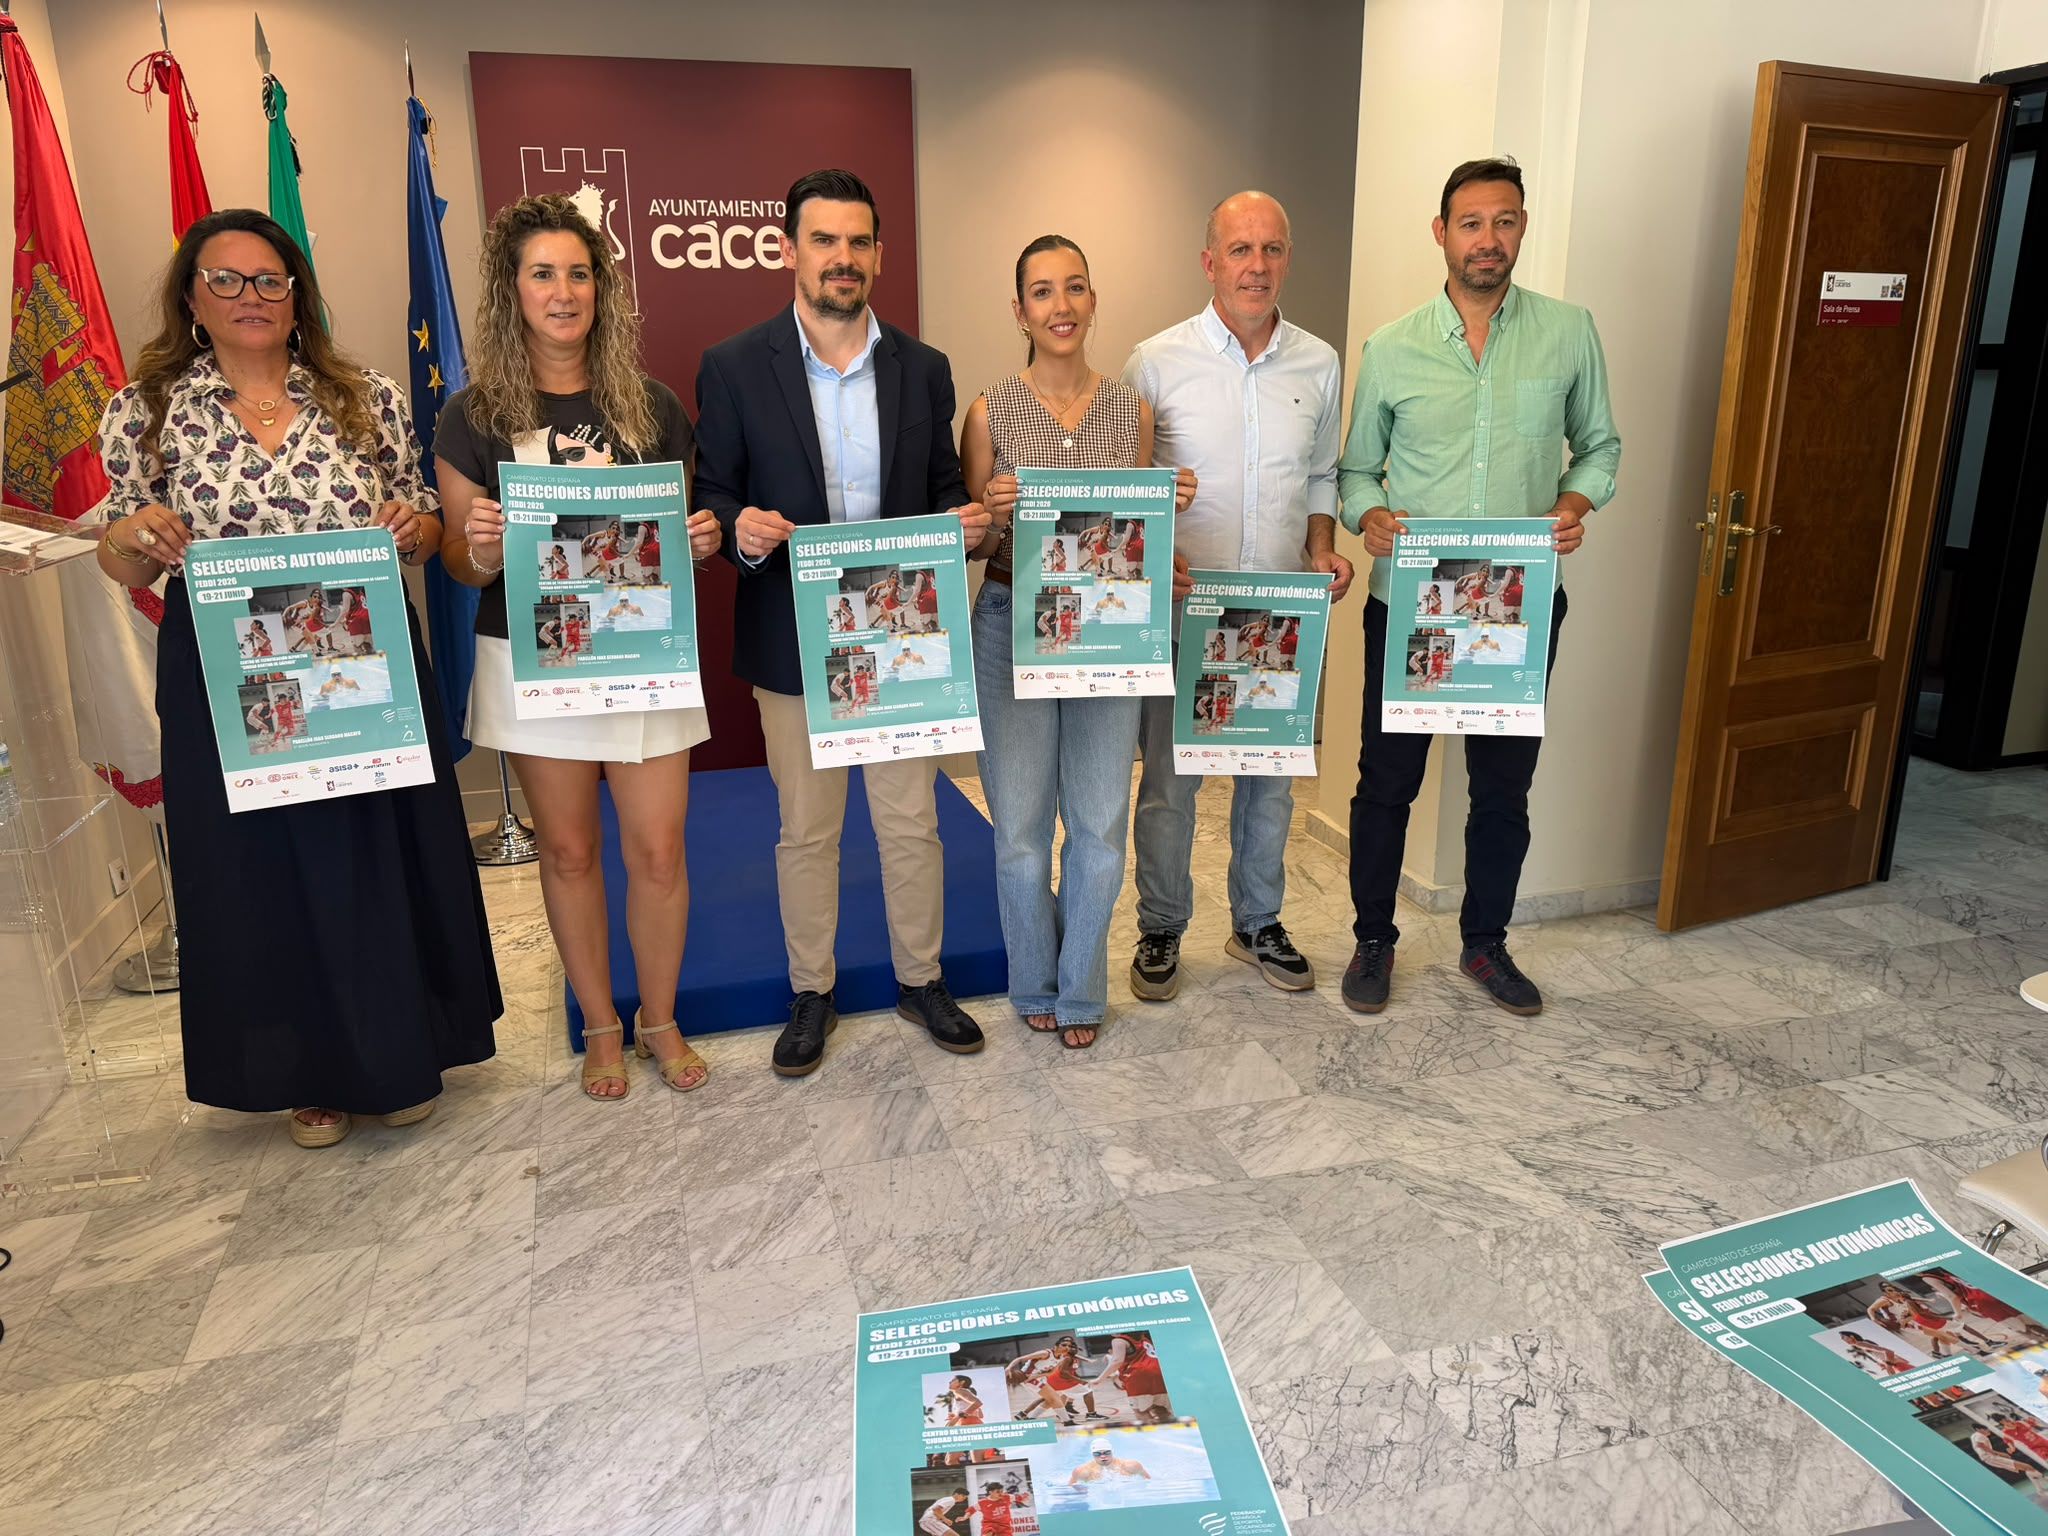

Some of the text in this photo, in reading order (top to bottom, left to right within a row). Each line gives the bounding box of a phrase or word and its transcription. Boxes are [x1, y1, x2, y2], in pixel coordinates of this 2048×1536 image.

[649, 198, 787, 218] AYUNTAMIENTO
[650, 219, 786, 270] cáce
[1824, 304, 1860, 312] Sala de Prensa
[507, 481, 680, 500] SELECCIONES AUTONÓMICAS
[1021, 483, 1170, 499] SELECCIONES AUTONÓMICAS
[508, 500, 544, 510] FEDDI 2026
[513, 513, 551, 523] 19-21 JUNIO
[796, 532, 958, 558] SELECCIONES AUTONÓMICAS
[1400, 532, 1552, 546] SELECCIONES AUTONÓMICAS
[192, 546, 390, 577] SELECCIONES AUTONÓMICAS
[814, 558, 832, 568] 2026
[195, 576, 237, 588] FEDDI 2026
[819, 570, 837, 578] JUNIO
[202, 588, 246, 601] 19-21 JUNIO
[1190, 584, 1326, 600] SELECCIONES AUTONÓMICAS
[1680, 1238, 1783, 1274] CAMPEONATO DE ESPAÑA
[1690, 1212, 1936, 1298] SELECCIONES AUTONÓMICAS
[1712, 1296, 1744, 1312] FEDDI
[1740, 1290, 1769, 1305] 2026
[870, 1288, 1190, 1342] SELECCIONES AUTONÓMICAS
[870, 1306, 1000, 1329] CAMPEONATO DE ESPAÑA
[1736, 1302, 1796, 1326] 19-21 JUNIO
[870, 1336, 936, 1352] FEDDI 2026
[878, 1346, 948, 1360] 19-21 JUNIO
[922, 1430, 948, 1438] CENTRO
[960, 1424, 1010, 1434] TECNIFICACIÓN
[1010, 1422, 1048, 1430] DEPORTIVA
